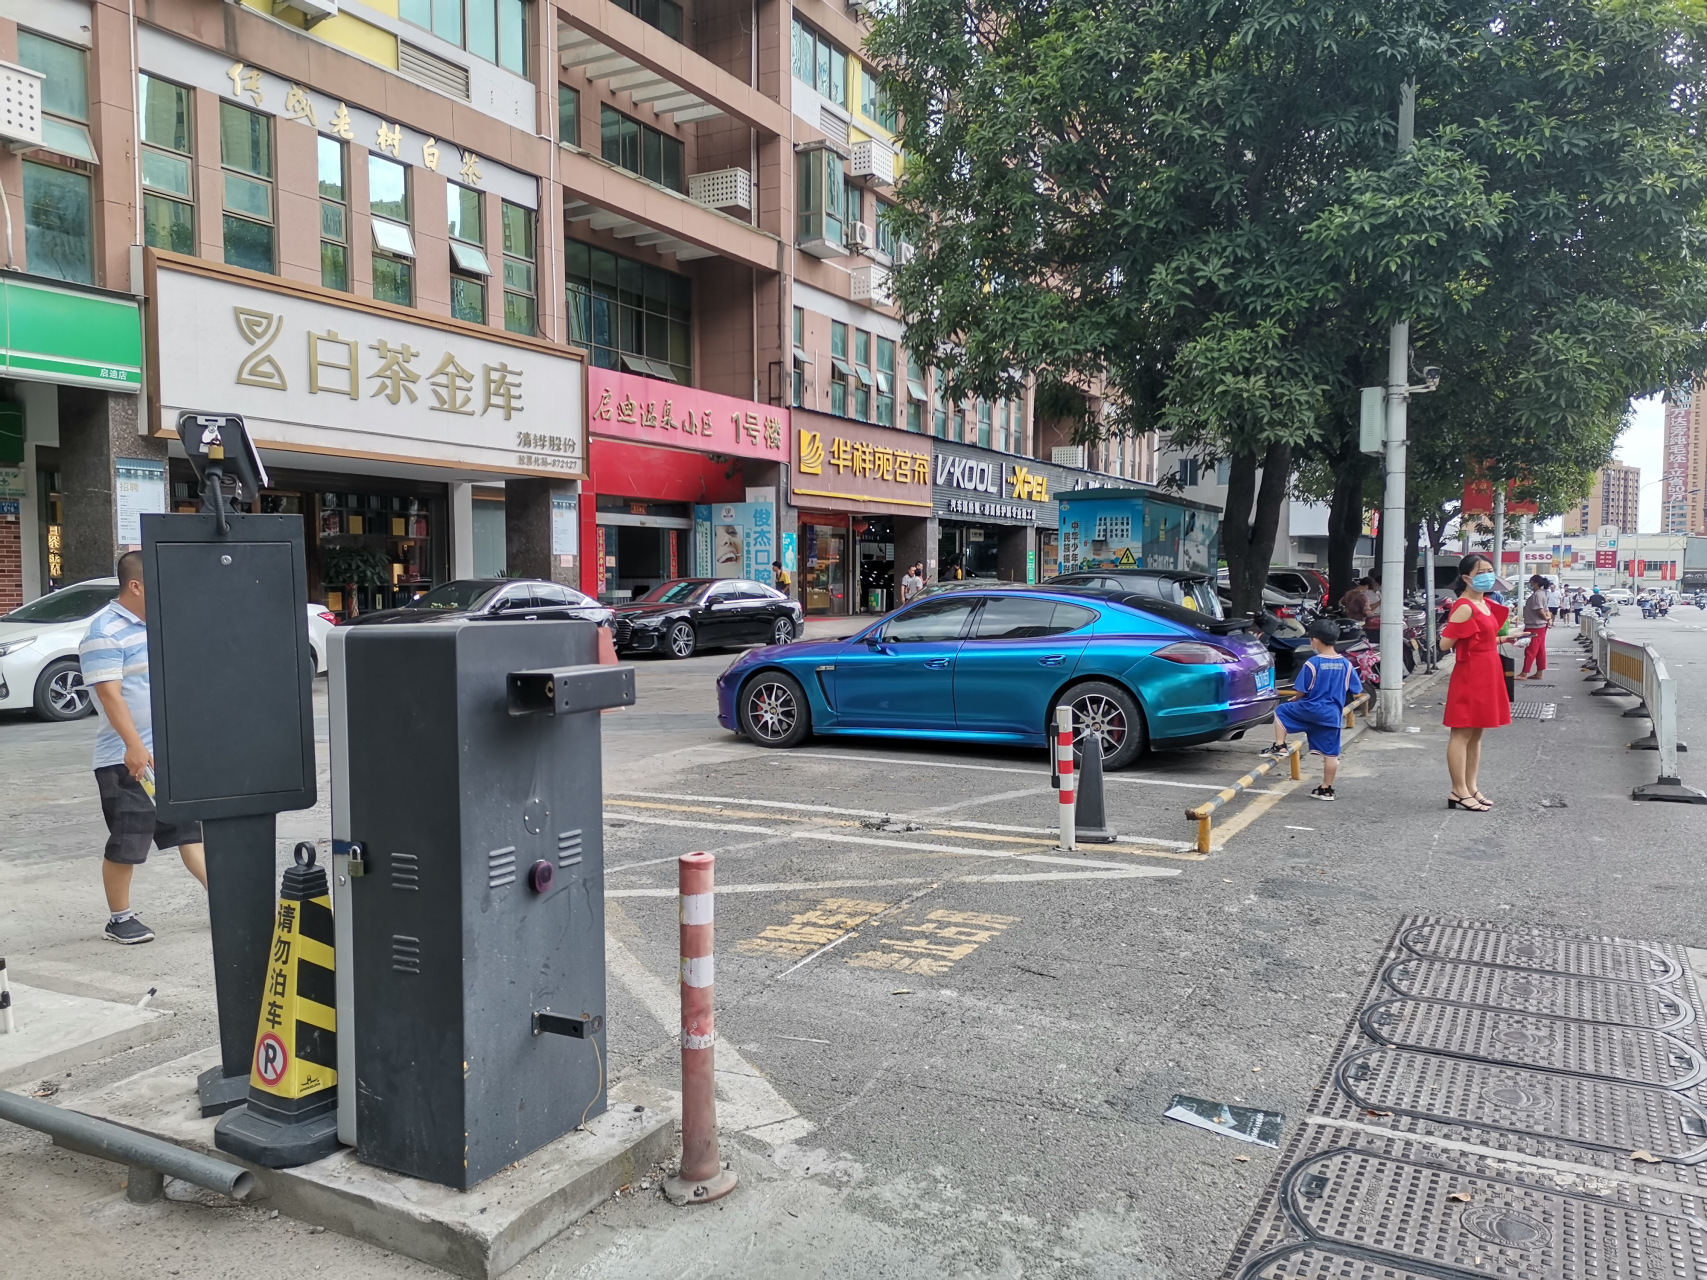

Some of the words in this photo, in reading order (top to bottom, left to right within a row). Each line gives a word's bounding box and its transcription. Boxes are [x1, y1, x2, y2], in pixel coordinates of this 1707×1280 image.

[99, 368, 128, 381] 启迪店
[306, 328, 525, 421] 白茶金库
[592, 387, 715, 437] 启迪温泉小区
[731, 410, 783, 451] 1号楼
[119, 481, 139, 493] 招聘
[829, 436, 931, 485] 华祥苑茗茶
[1011, 464, 1050, 503] XPEL
[753, 507, 772, 586] 俊杰口腔
[265, 903, 297, 1030] 请勿泊车
[842, 908, 1022, 977] 禁止占用
